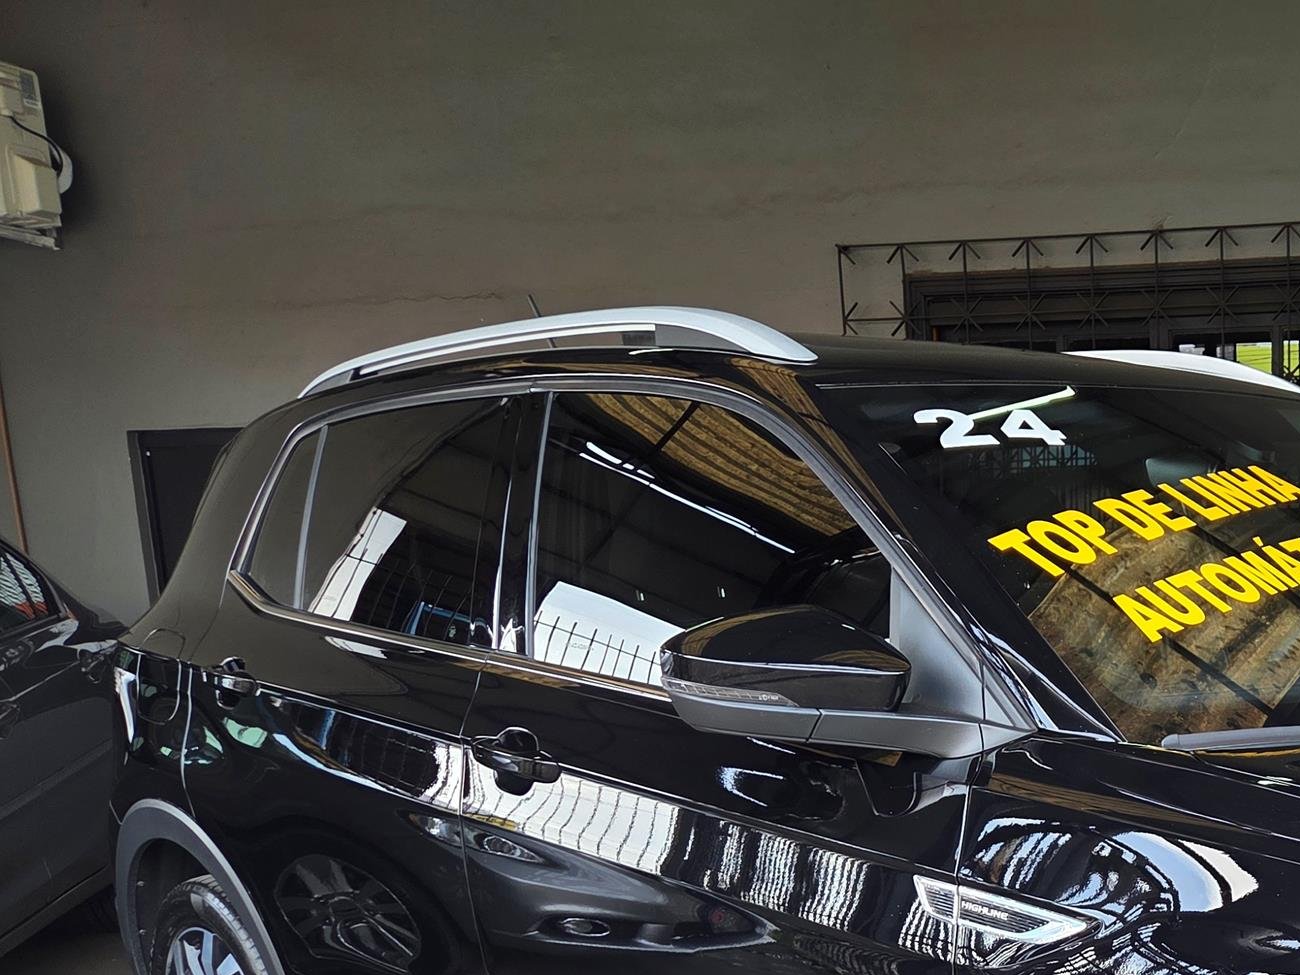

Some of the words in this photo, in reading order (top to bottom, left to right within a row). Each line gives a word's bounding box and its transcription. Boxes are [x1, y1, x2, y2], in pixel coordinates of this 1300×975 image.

[913, 408, 1068, 449] 24
[988, 510, 1118, 577] TOP
[1094, 489, 1196, 541] DE
[961, 900, 1009, 920] HIGHLINE
